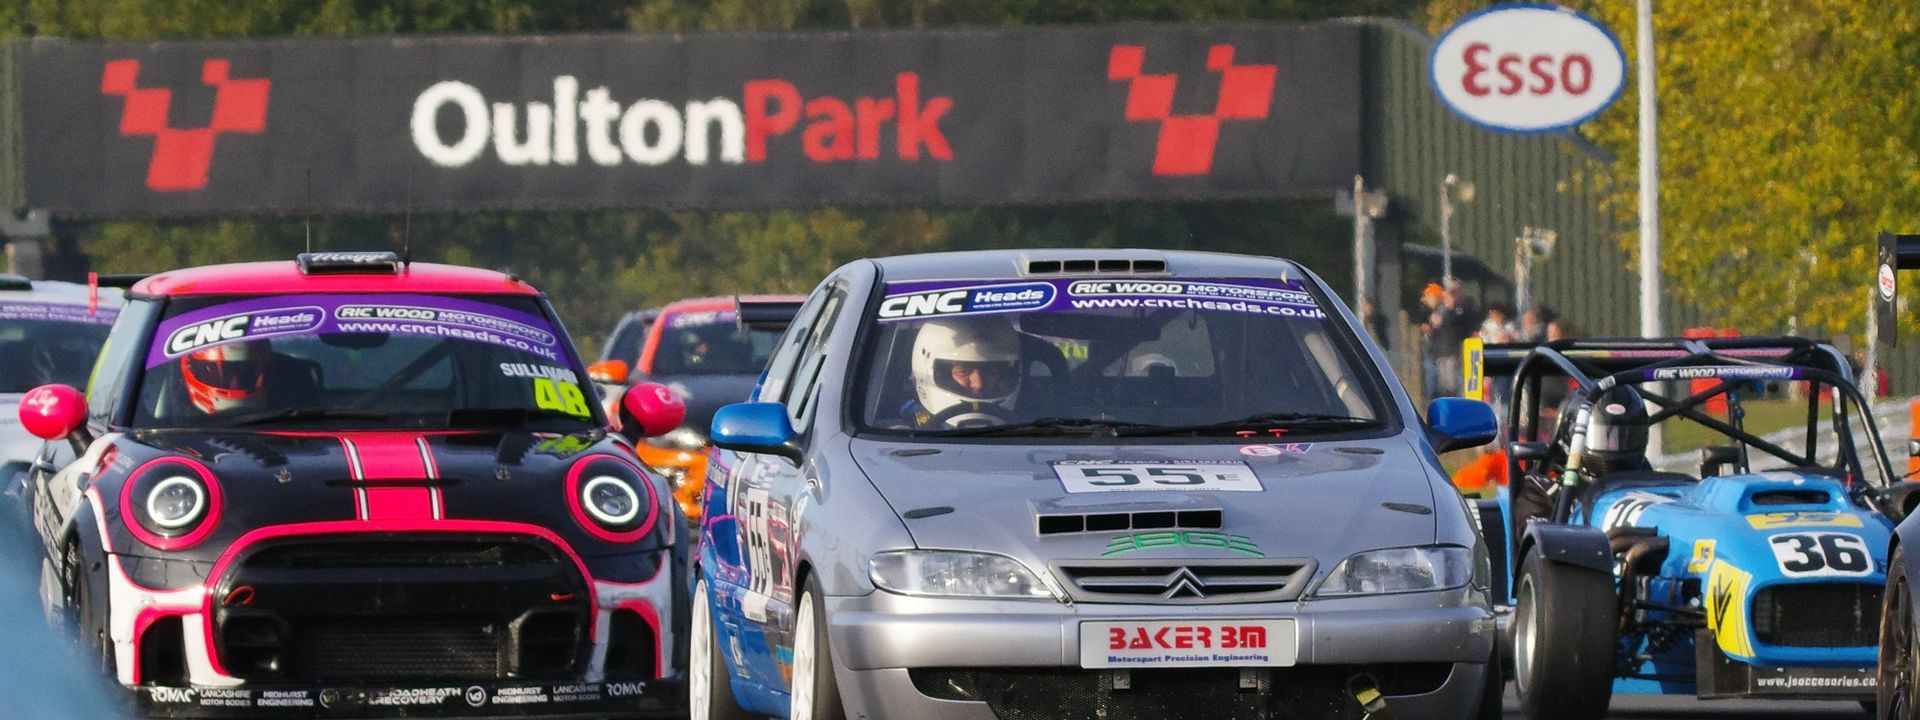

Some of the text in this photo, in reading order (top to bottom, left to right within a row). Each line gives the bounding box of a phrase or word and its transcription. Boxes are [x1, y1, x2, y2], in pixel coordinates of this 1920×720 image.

[1462, 42, 1593, 96] Esso
[1075, 283, 1111, 293] RIC
[1115, 283, 1183, 294] WOOD
[879, 289, 1044, 318] CNC Heads
[1071, 298, 1327, 319] www.cncheads.co.uk
[171, 312, 315, 352] CNC Heads
[341, 307, 550, 340] RIC WOOD MOTORSPORT
[337, 322, 556, 360] www.cncheads.co.uk
[500, 362, 578, 384] SULLIVAN
[1657, 366, 1789, 378] RIC WOOD MOTORSPORT
[534, 377, 591, 418] 48
[1080, 467, 1206, 486] 55
[1772, 533, 1869, 573] 36
[1109, 626, 1212, 649] BAKER
[1108, 654, 1269, 664] Motorsport Precision Engineering
[201, 690, 251, 698] LANCASHIRE
[263, 691, 308, 699] MIDHURST
[491, 695, 548, 704] ENGINEERING
[498, 687, 542, 696] MIDHURST
[553, 685, 600, 694] LANCASHIRE
[606, 682, 647, 697] ROMAC
